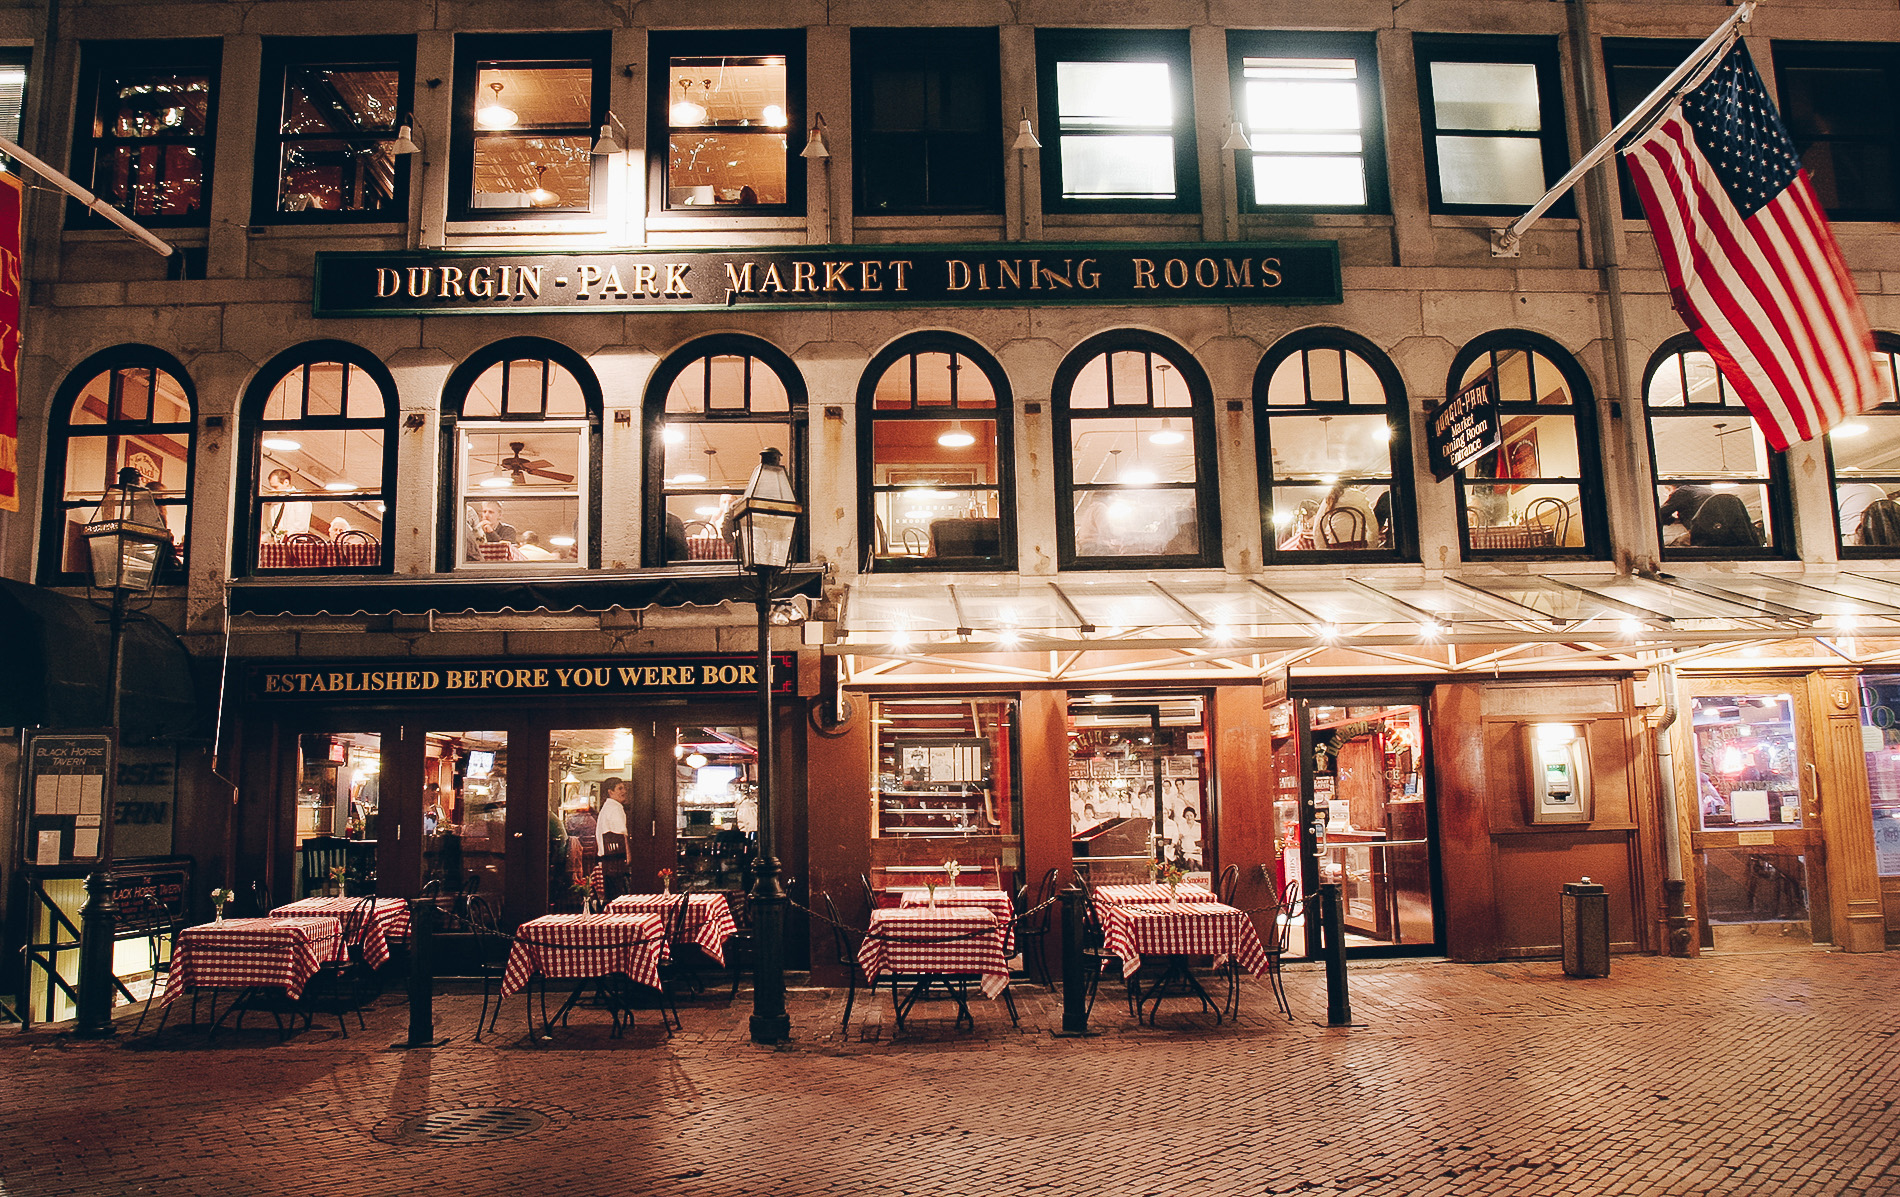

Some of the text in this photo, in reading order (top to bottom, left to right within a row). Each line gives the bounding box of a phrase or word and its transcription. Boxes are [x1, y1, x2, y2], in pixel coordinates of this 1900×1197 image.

[723, 260, 913, 295] MARKET
[946, 258, 1102, 291] DINING
[1132, 257, 1283, 289] ROOMS
[1435, 384, 1489, 437] DURGIN-PARK
[1442, 420, 1488, 457] Dining Room
[1451, 413, 1474, 437] Market
[1450, 438, 1482, 466] Entrance
[264, 670, 439, 693] ESTABLISHED
[446, 668, 550, 690] BEFORE
[556, 667, 610, 688] YOU
[617, 665, 695, 686] WERE
[36, 746, 105, 757] BLACK HORSE
[52, 757, 87, 766] TAVERN
[112, 888, 133, 900] LACK
